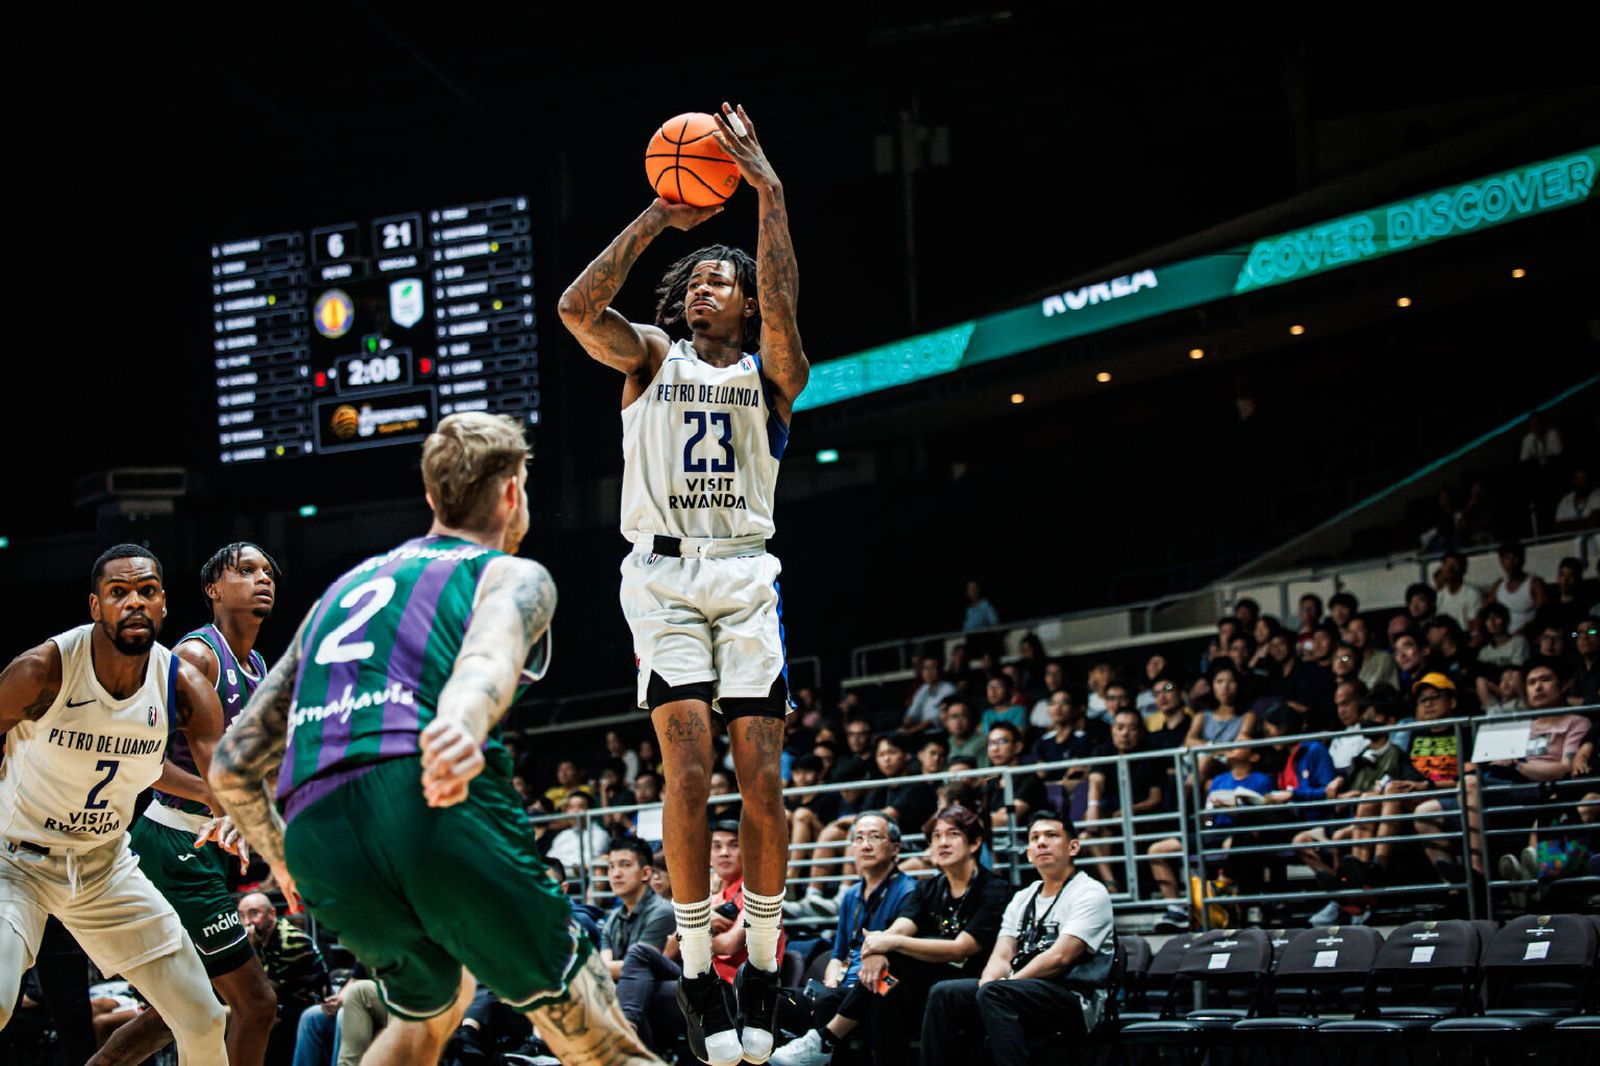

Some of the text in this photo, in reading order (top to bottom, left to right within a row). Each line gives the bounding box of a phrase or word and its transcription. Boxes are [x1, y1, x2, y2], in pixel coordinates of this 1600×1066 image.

[1387, 156, 1595, 249] DISCOVER
[327, 233, 345, 258] 6
[383, 221, 411, 249] 21
[657, 384, 759, 407] PETRO DE LUANDA
[684, 411, 735, 472] 23
[686, 478, 734, 492] VISIT
[668, 493, 747, 510] RWANDA
[314, 576, 396, 665] 2
[48, 728, 162, 755] PETRO DE LUANDA
[84, 759, 120, 809] 2
[69, 811, 114, 825] VISIT
